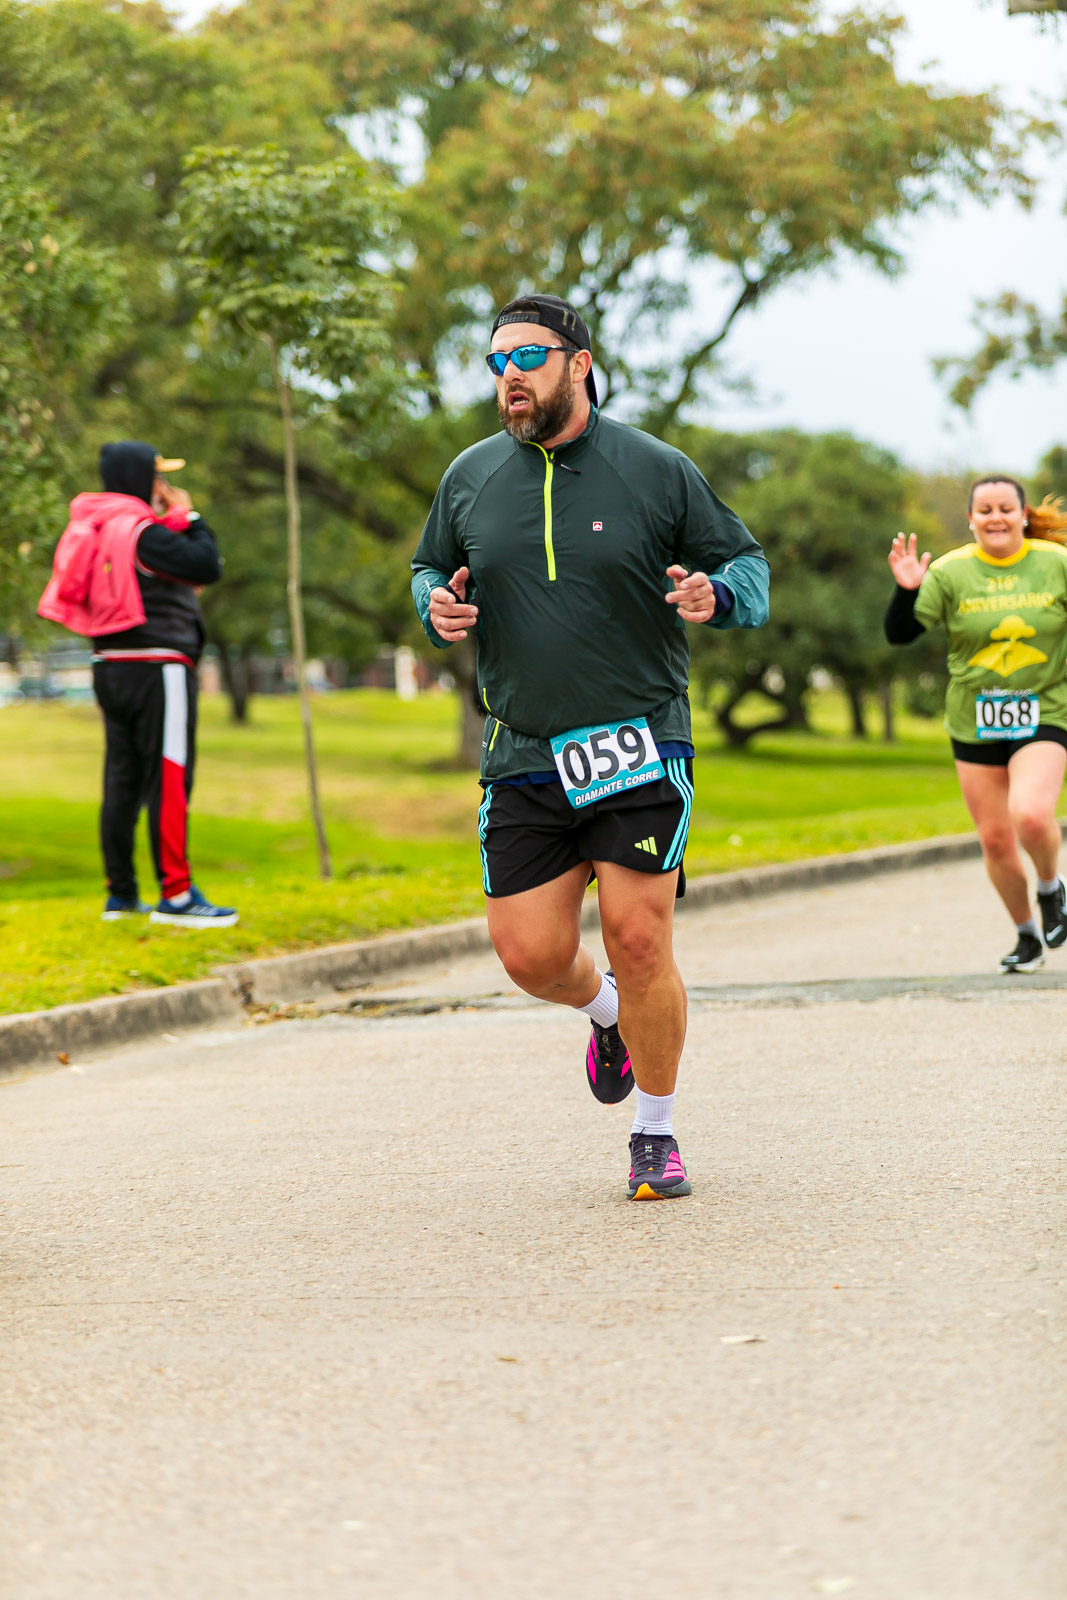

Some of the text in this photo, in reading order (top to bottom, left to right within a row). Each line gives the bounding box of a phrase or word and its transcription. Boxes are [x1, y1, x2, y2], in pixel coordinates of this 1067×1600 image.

[982, 696, 1032, 727] 068
[562, 724, 646, 789] 059
[575, 769, 659, 806] DIAMANTE CORRE
